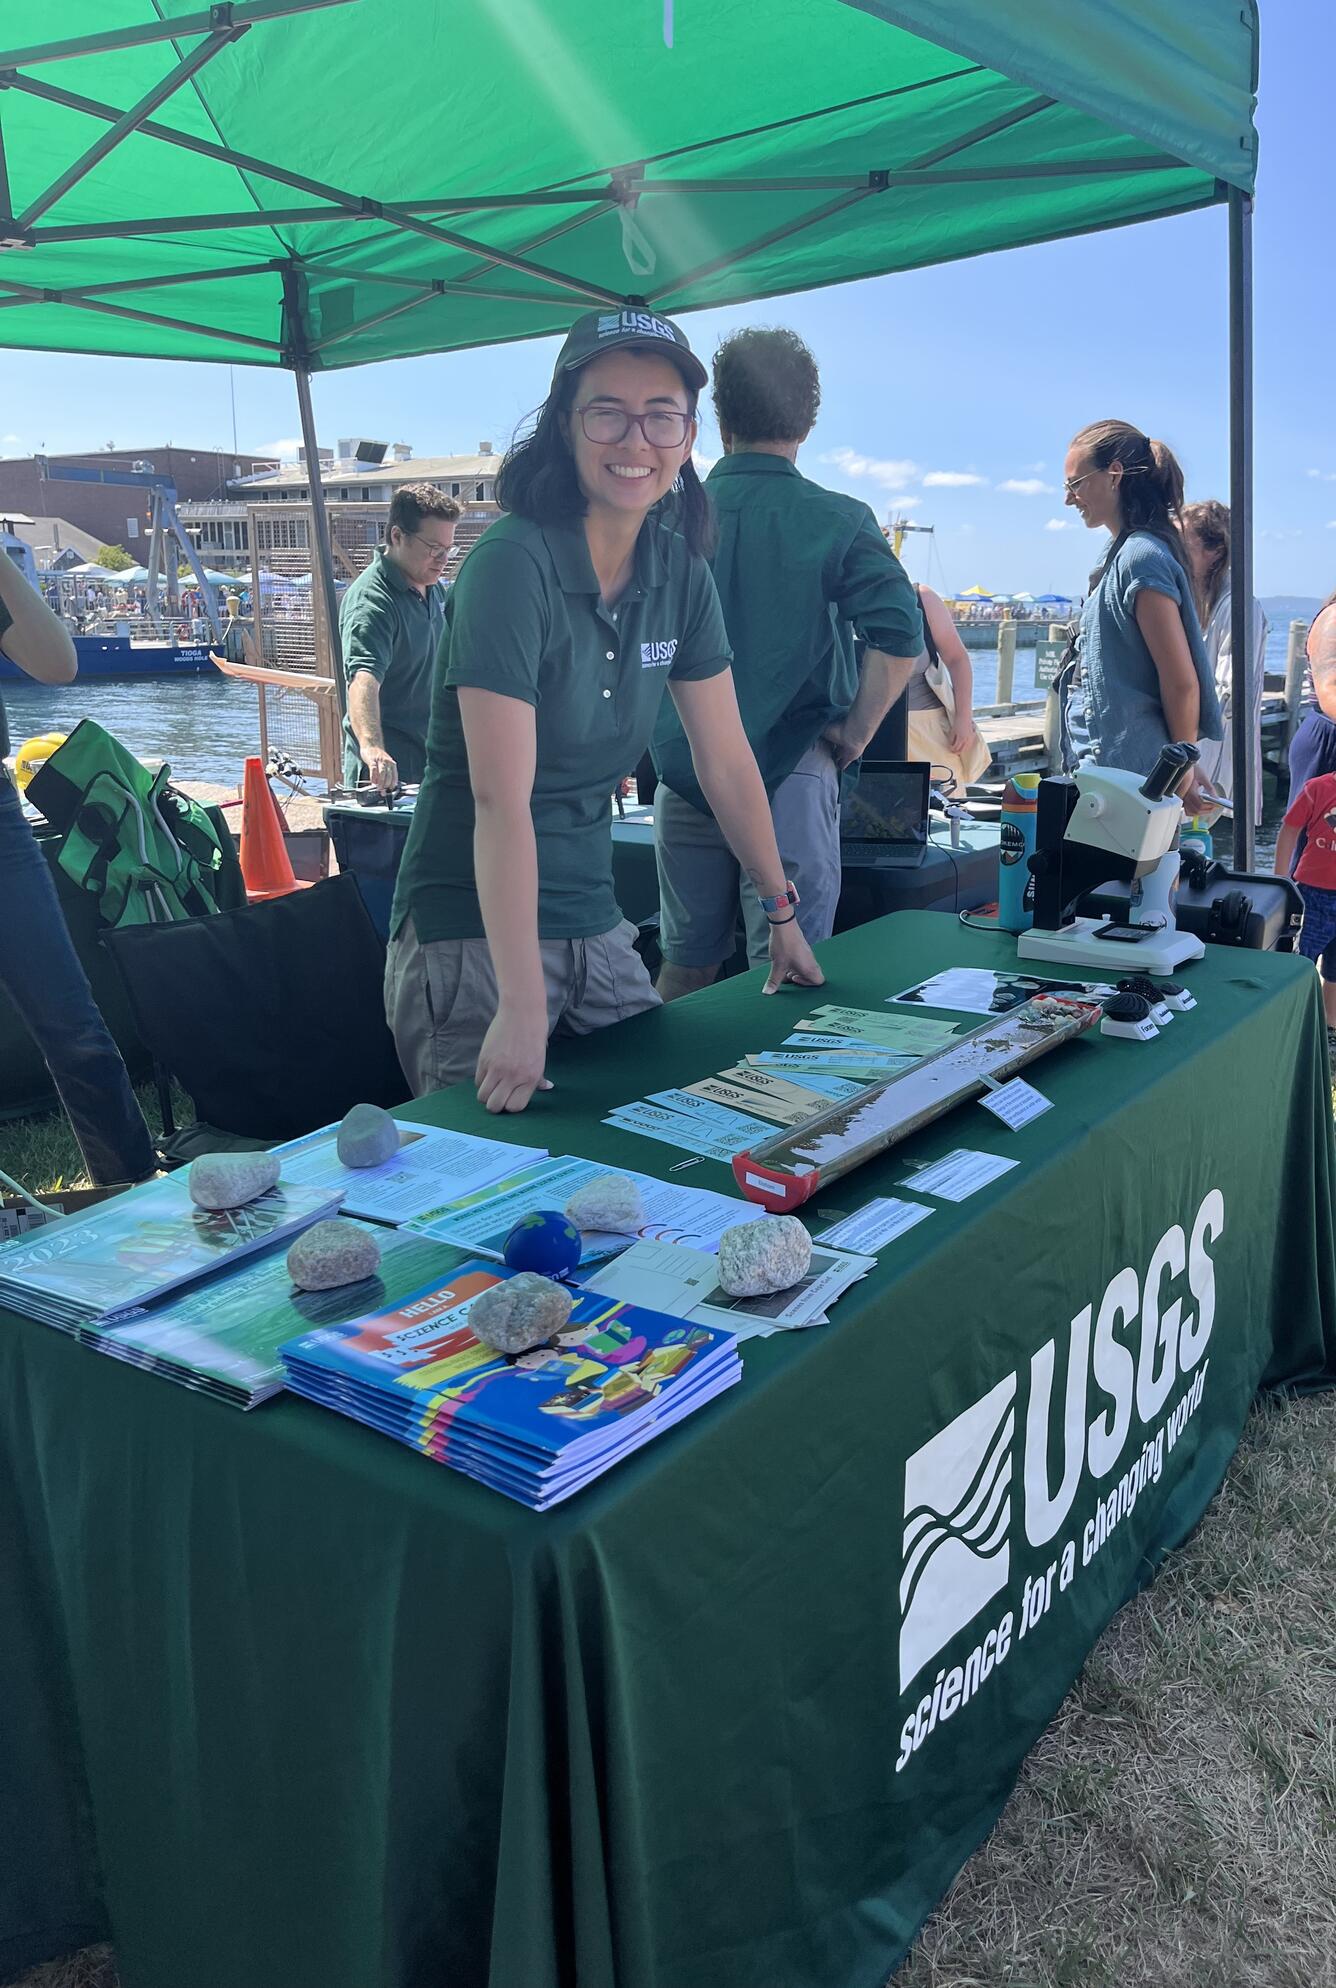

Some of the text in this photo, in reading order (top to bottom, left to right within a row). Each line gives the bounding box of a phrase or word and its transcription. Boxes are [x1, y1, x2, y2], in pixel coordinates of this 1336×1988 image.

[622, 311, 675, 342] USGS
[839, 1009, 869, 1018] USGS
[837, 1023, 864, 1033] USGS
[745, 1070, 774, 1085] USGS
[678, 1095, 705, 1108] USGS
[713, 1086, 744, 1099] USGS
[643, 1109, 675, 1121] USGS
[3, 1229, 99, 1273] 2023
[399, 1291, 456, 1318] HELLO
[396, 1313, 458, 1342] SCIENCE
[1025, 1189, 1224, 1547] USGS
[896, 1358, 1210, 1772] science for a changing world
